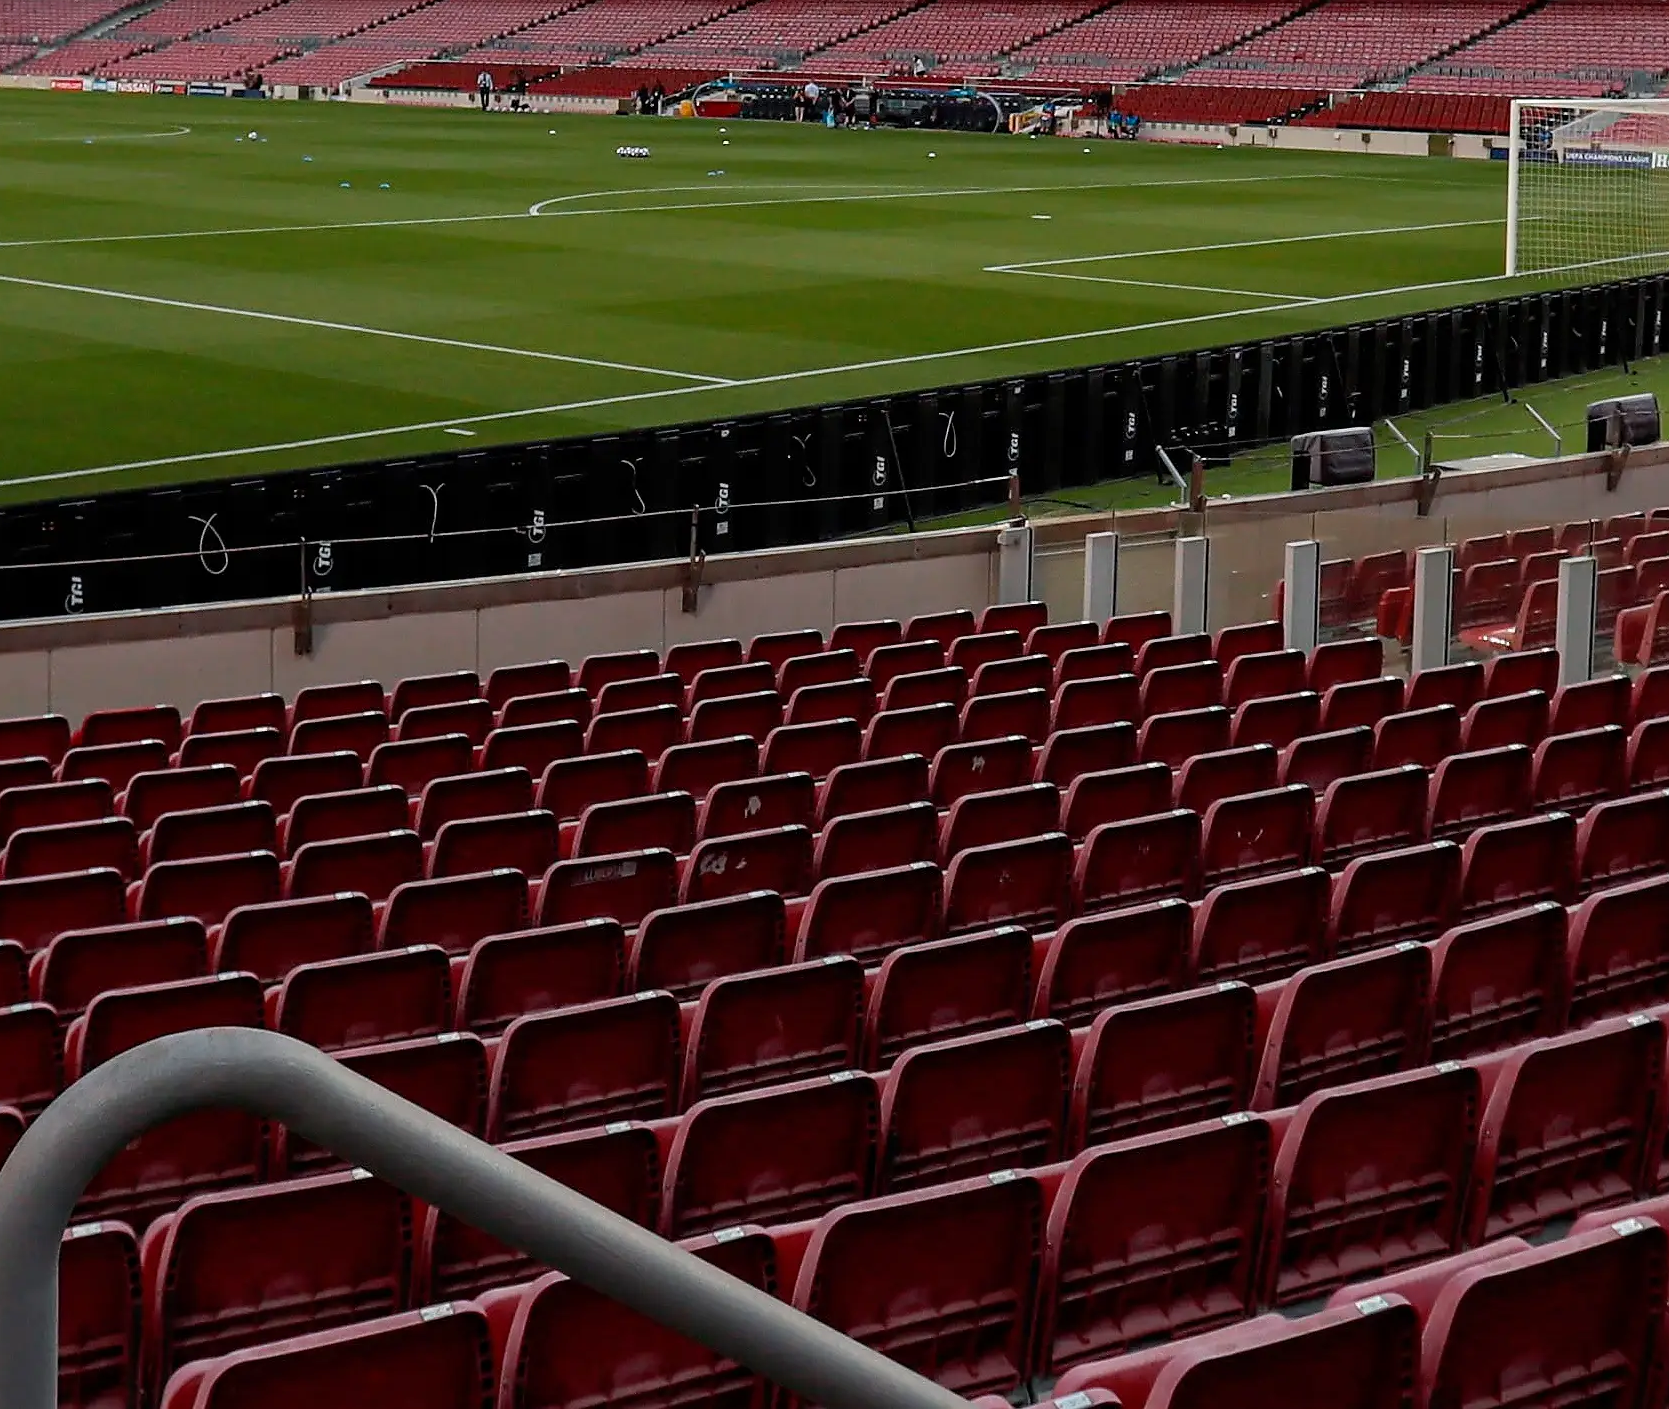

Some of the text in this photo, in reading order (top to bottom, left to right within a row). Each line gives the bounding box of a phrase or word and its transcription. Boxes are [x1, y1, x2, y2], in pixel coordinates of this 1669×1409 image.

[117, 82, 150, 93] NISSAN
[1565, 151, 1650, 164] UEFA CHAMPIONS LEAGUE
[1010, 433, 1019, 455] TGI
[875, 455, 885, 480] TGI
[719, 482, 730, 508] TGI
[533, 509, 545, 536] TGI
[319, 541, 332, 568] TGI
[71, 575, 84, 606] TGI
